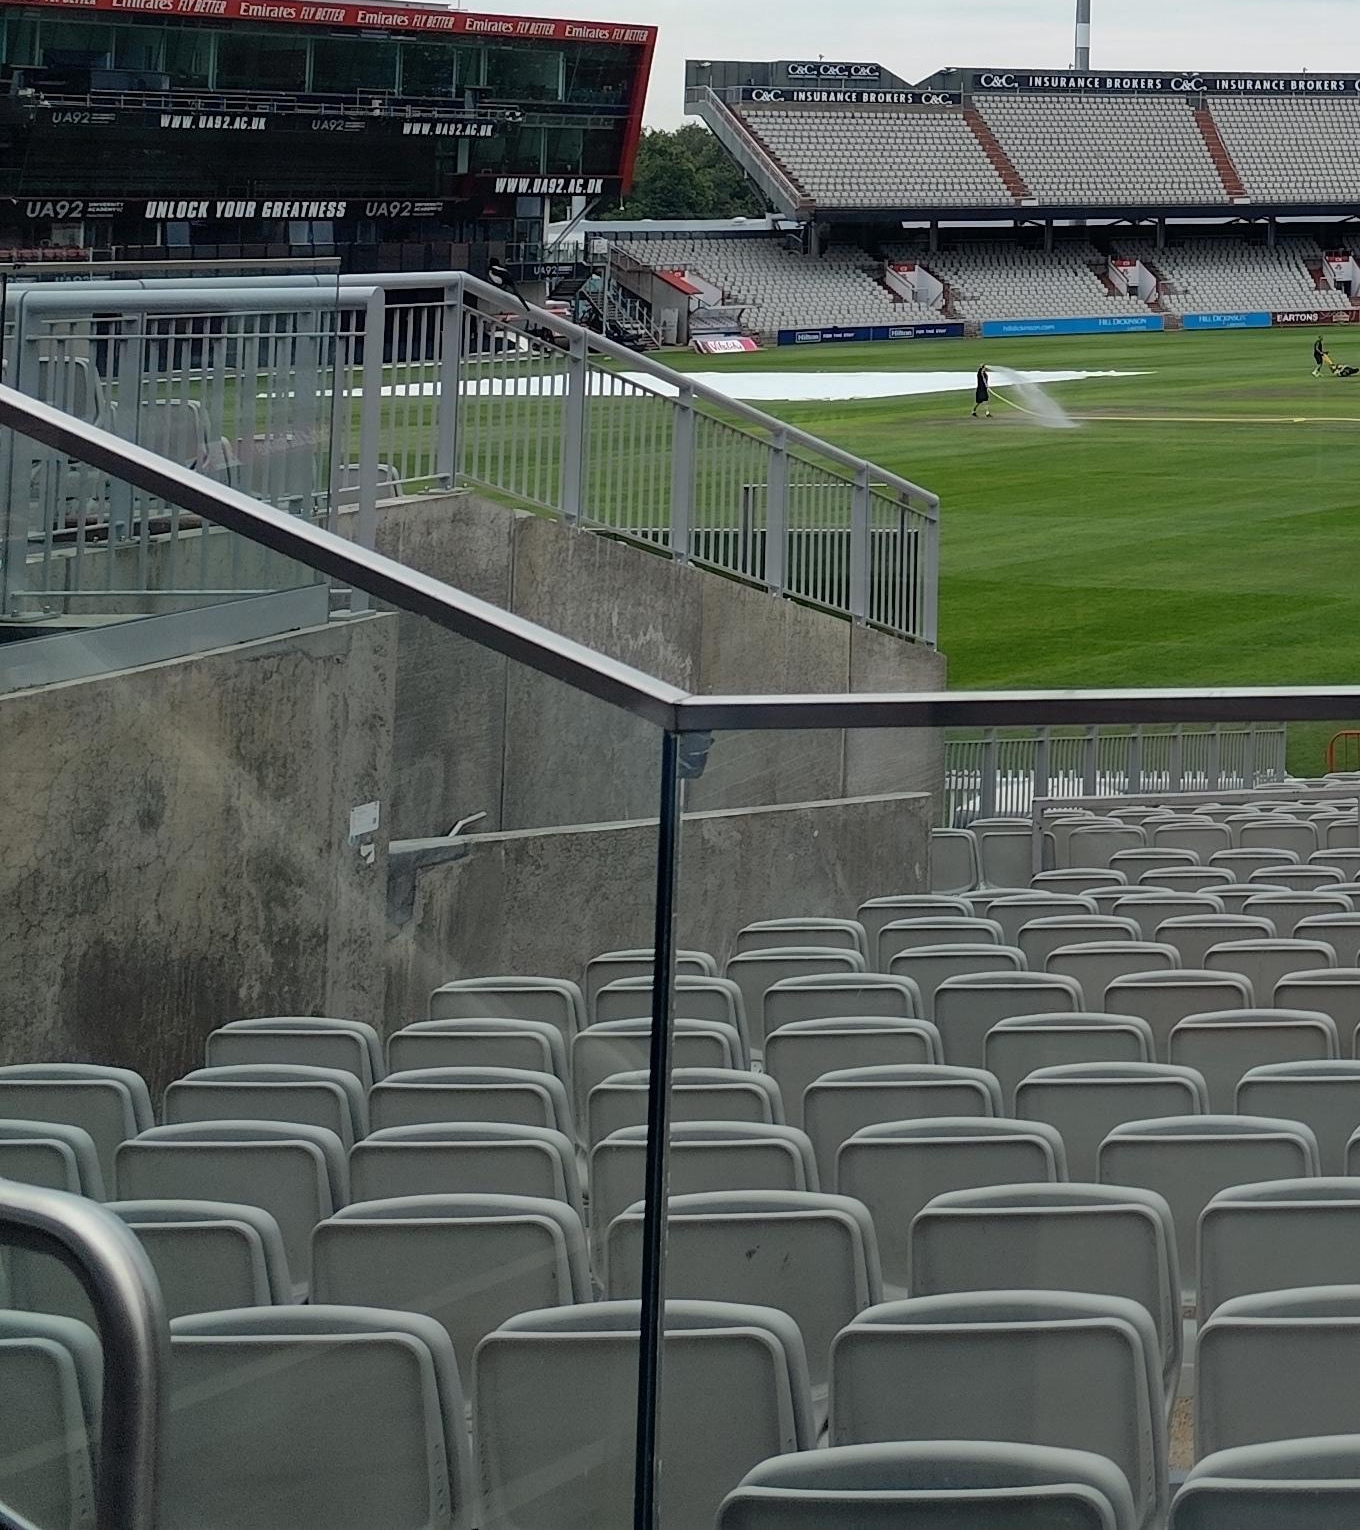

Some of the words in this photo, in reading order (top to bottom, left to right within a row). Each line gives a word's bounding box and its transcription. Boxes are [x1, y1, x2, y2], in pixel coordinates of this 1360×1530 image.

[193, 0, 227, 14] BETTER
[239, 2, 296, 18] Emirates
[300, 6, 316, 20] FLY
[315, 7, 345, 22] BETTER
[357, 10, 409, 26] Emirates
[412, 14, 428, 27] FLY
[426, 15, 455, 29] BETTER
[465, 18, 513, 32] Emirates
[516, 22, 530, 34] FLY
[529, 23, 555, 36] BETTER
[565, 25, 610, 39] Emirates
[612, 28, 626, 40] FLY
[624, 29, 649, 42] BETTER
[1029, 76, 1100, 88] INSURANCE
[1106, 78, 1162, 90] BROKERS
[1216, 79, 1285, 90] INSURANCE
[1291, 79, 1345, 91] BROKERS
[793, 91, 857, 102] INSURANCE
[862, 92, 913, 104] BROKERS
[52, 112, 90, 123] UA92
[160, 114, 266, 130] WWW.UA92.AC.UK
[311, 120, 345, 131] UA92
[403, 122, 493, 137] WWW.UA92.AC.UK
[495, 178, 603, 194] WWW.UA92.AC.UK
[26, 201, 84, 218] UA92
[145, 201, 209, 218] UNLOCK
[216, 201, 257, 218] YOUR
[261, 201, 347, 218] GREATNESS
[365, 202, 411, 217] UA92
[534, 266, 557, 275] UA92
